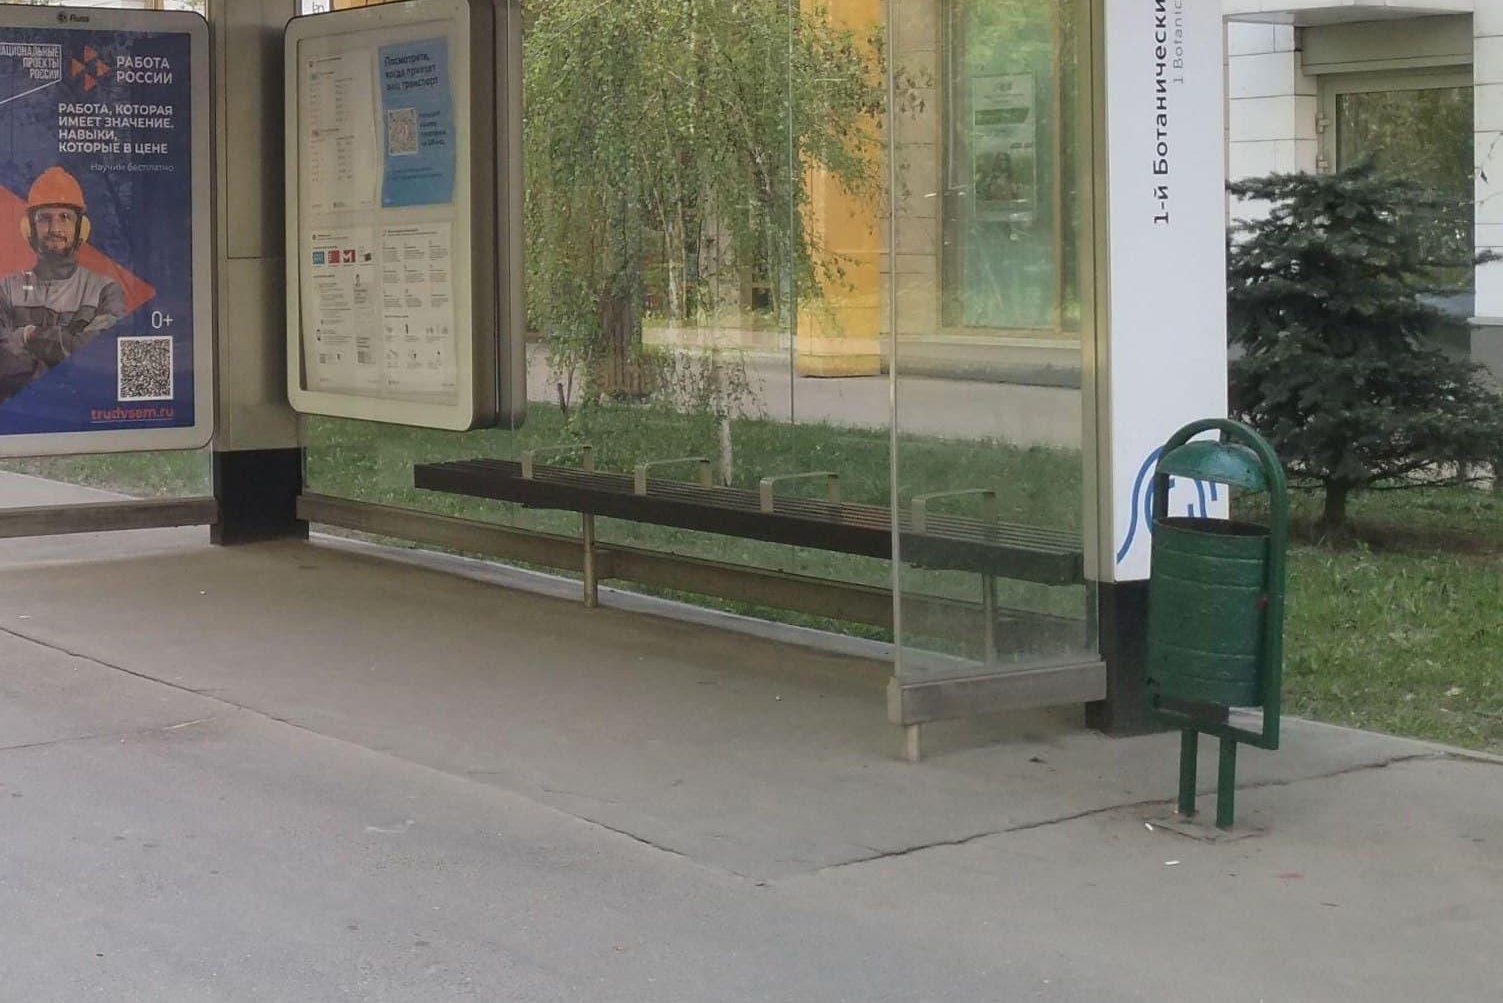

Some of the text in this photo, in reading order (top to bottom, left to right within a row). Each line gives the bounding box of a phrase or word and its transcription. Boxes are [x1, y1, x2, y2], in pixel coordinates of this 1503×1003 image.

[23, 57, 60, 69] ПРОЕКТЫ
[116, 56, 171, 70] РАБОТА
[30, 68, 60, 79] РОССИИ
[116, 70, 174, 85] РОССИИ
[58, 103, 174, 116] РАБОТА, КОТОРАЯ
[58, 116, 175, 129] ИМЕЕТ ЗНАЧЕНИЕ.
[58, 129, 118, 141] НАВЫКИ,
[58, 142, 169, 155] КОТОРЫЕ В ЦЕНЕ
[1152, 185, 1170, 225] 1-й
[151, 310, 174, 329] 0+
[90, 407, 175, 420] trudvsem.ru
